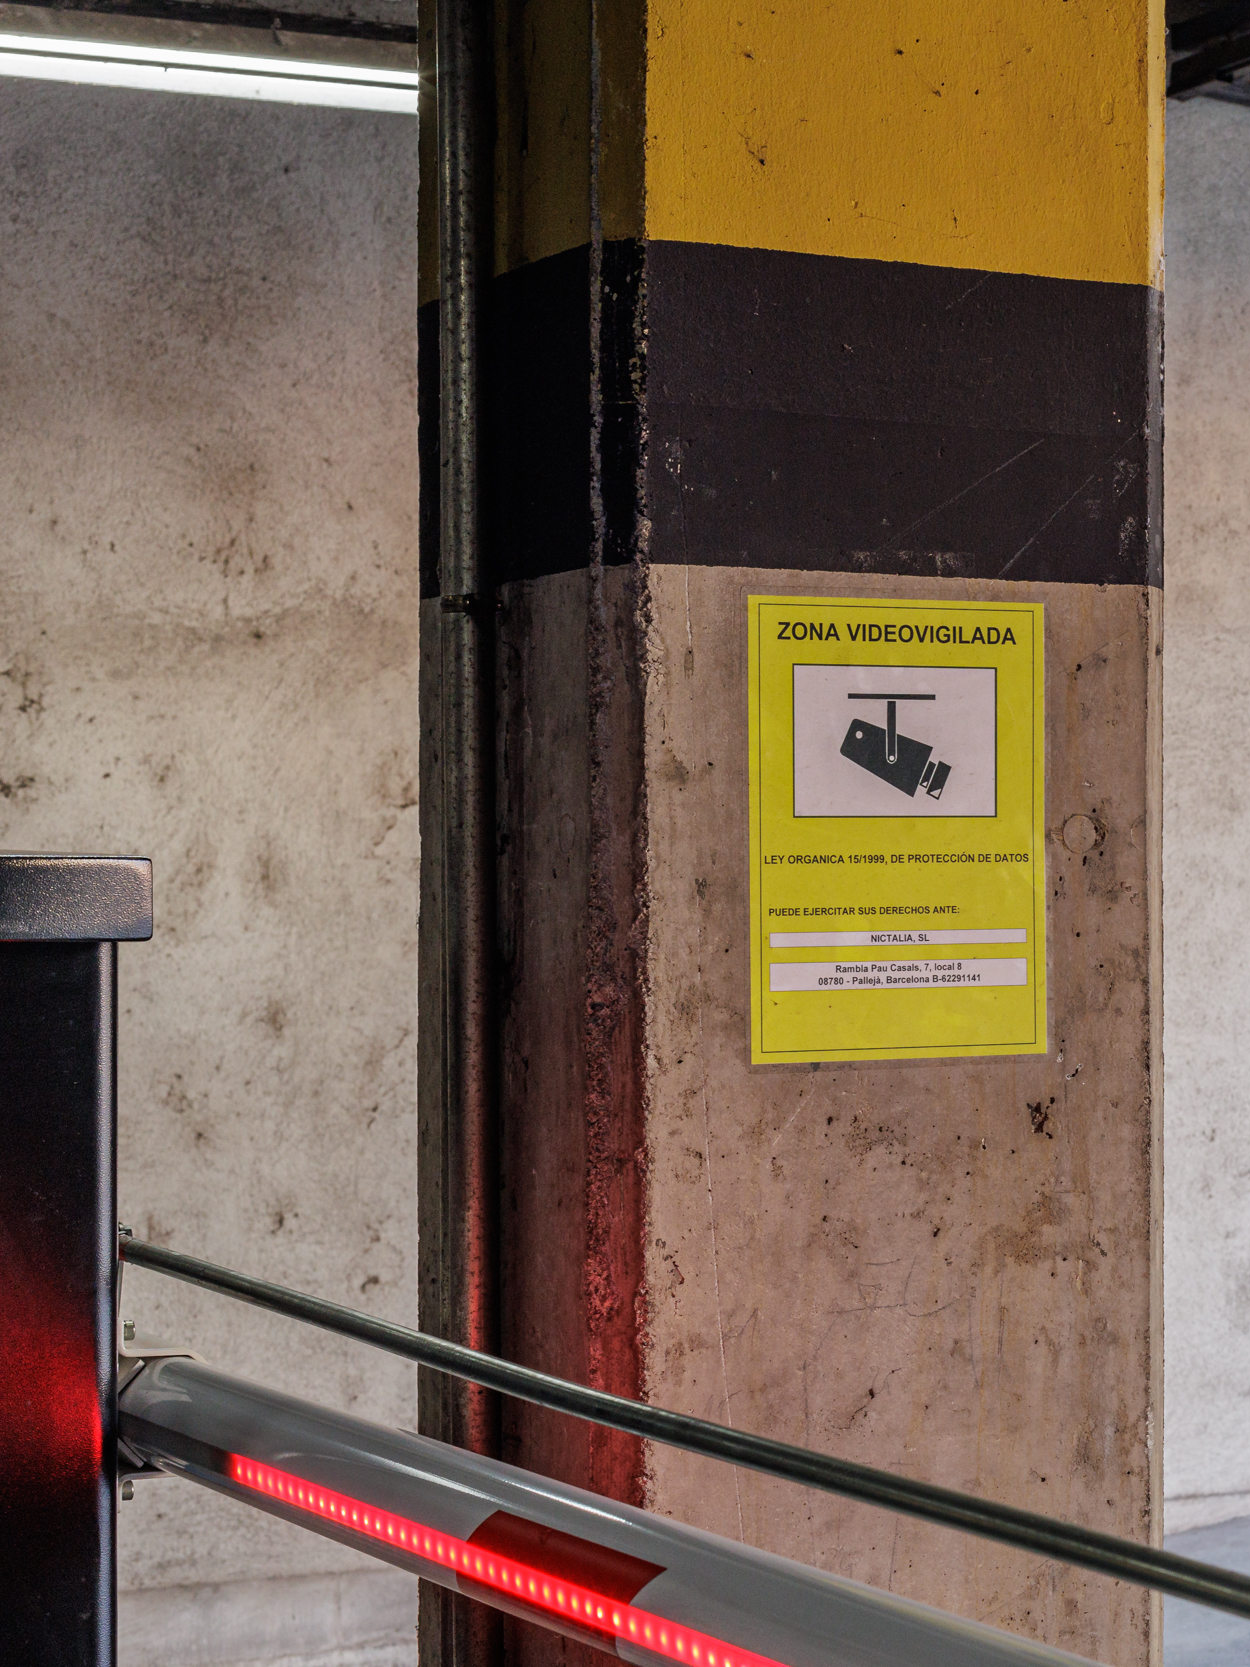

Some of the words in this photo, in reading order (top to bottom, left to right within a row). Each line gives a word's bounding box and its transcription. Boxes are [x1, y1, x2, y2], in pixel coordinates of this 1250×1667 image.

[777, 621, 841, 642] ZONA
[847, 623, 1017, 645] VIDEOVIGILADA
[764, 855, 785, 865] LEY
[787, 855, 845, 864] ORGANICA
[847, 854, 888, 866] 15/1999,
[890, 854, 905, 864] DE
[907, 851, 975, 863] PROTECCIÓN
[978, 853, 992, 863] DE
[994, 853, 1029, 863] DATOS
[768, 907, 801, 917] PUEDE
[803, 907, 856, 916] EJERCITAR
[858, 906, 877, 916] SUS
[879, 906, 931, 915] DERECHOS
[932, 905, 960, 914] ANTE:
[870, 934, 916, 943] NICTALIA,
[918, 934, 930, 942] SL
[835, 964, 868, 973] Rambla
[871, 964, 888, 973] Pau
[890, 963, 922, 973] Casals,
[924, 963, 932, 972] 7,
[934, 962, 955, 971] local
[957, 962, 962, 971] 8
[818, 977, 844, 986] 08780
[852, 975, 884, 986] Pallejà,
[886, 975, 930, 985] Barcelona
[932, 974, 981, 983] B-62291141
